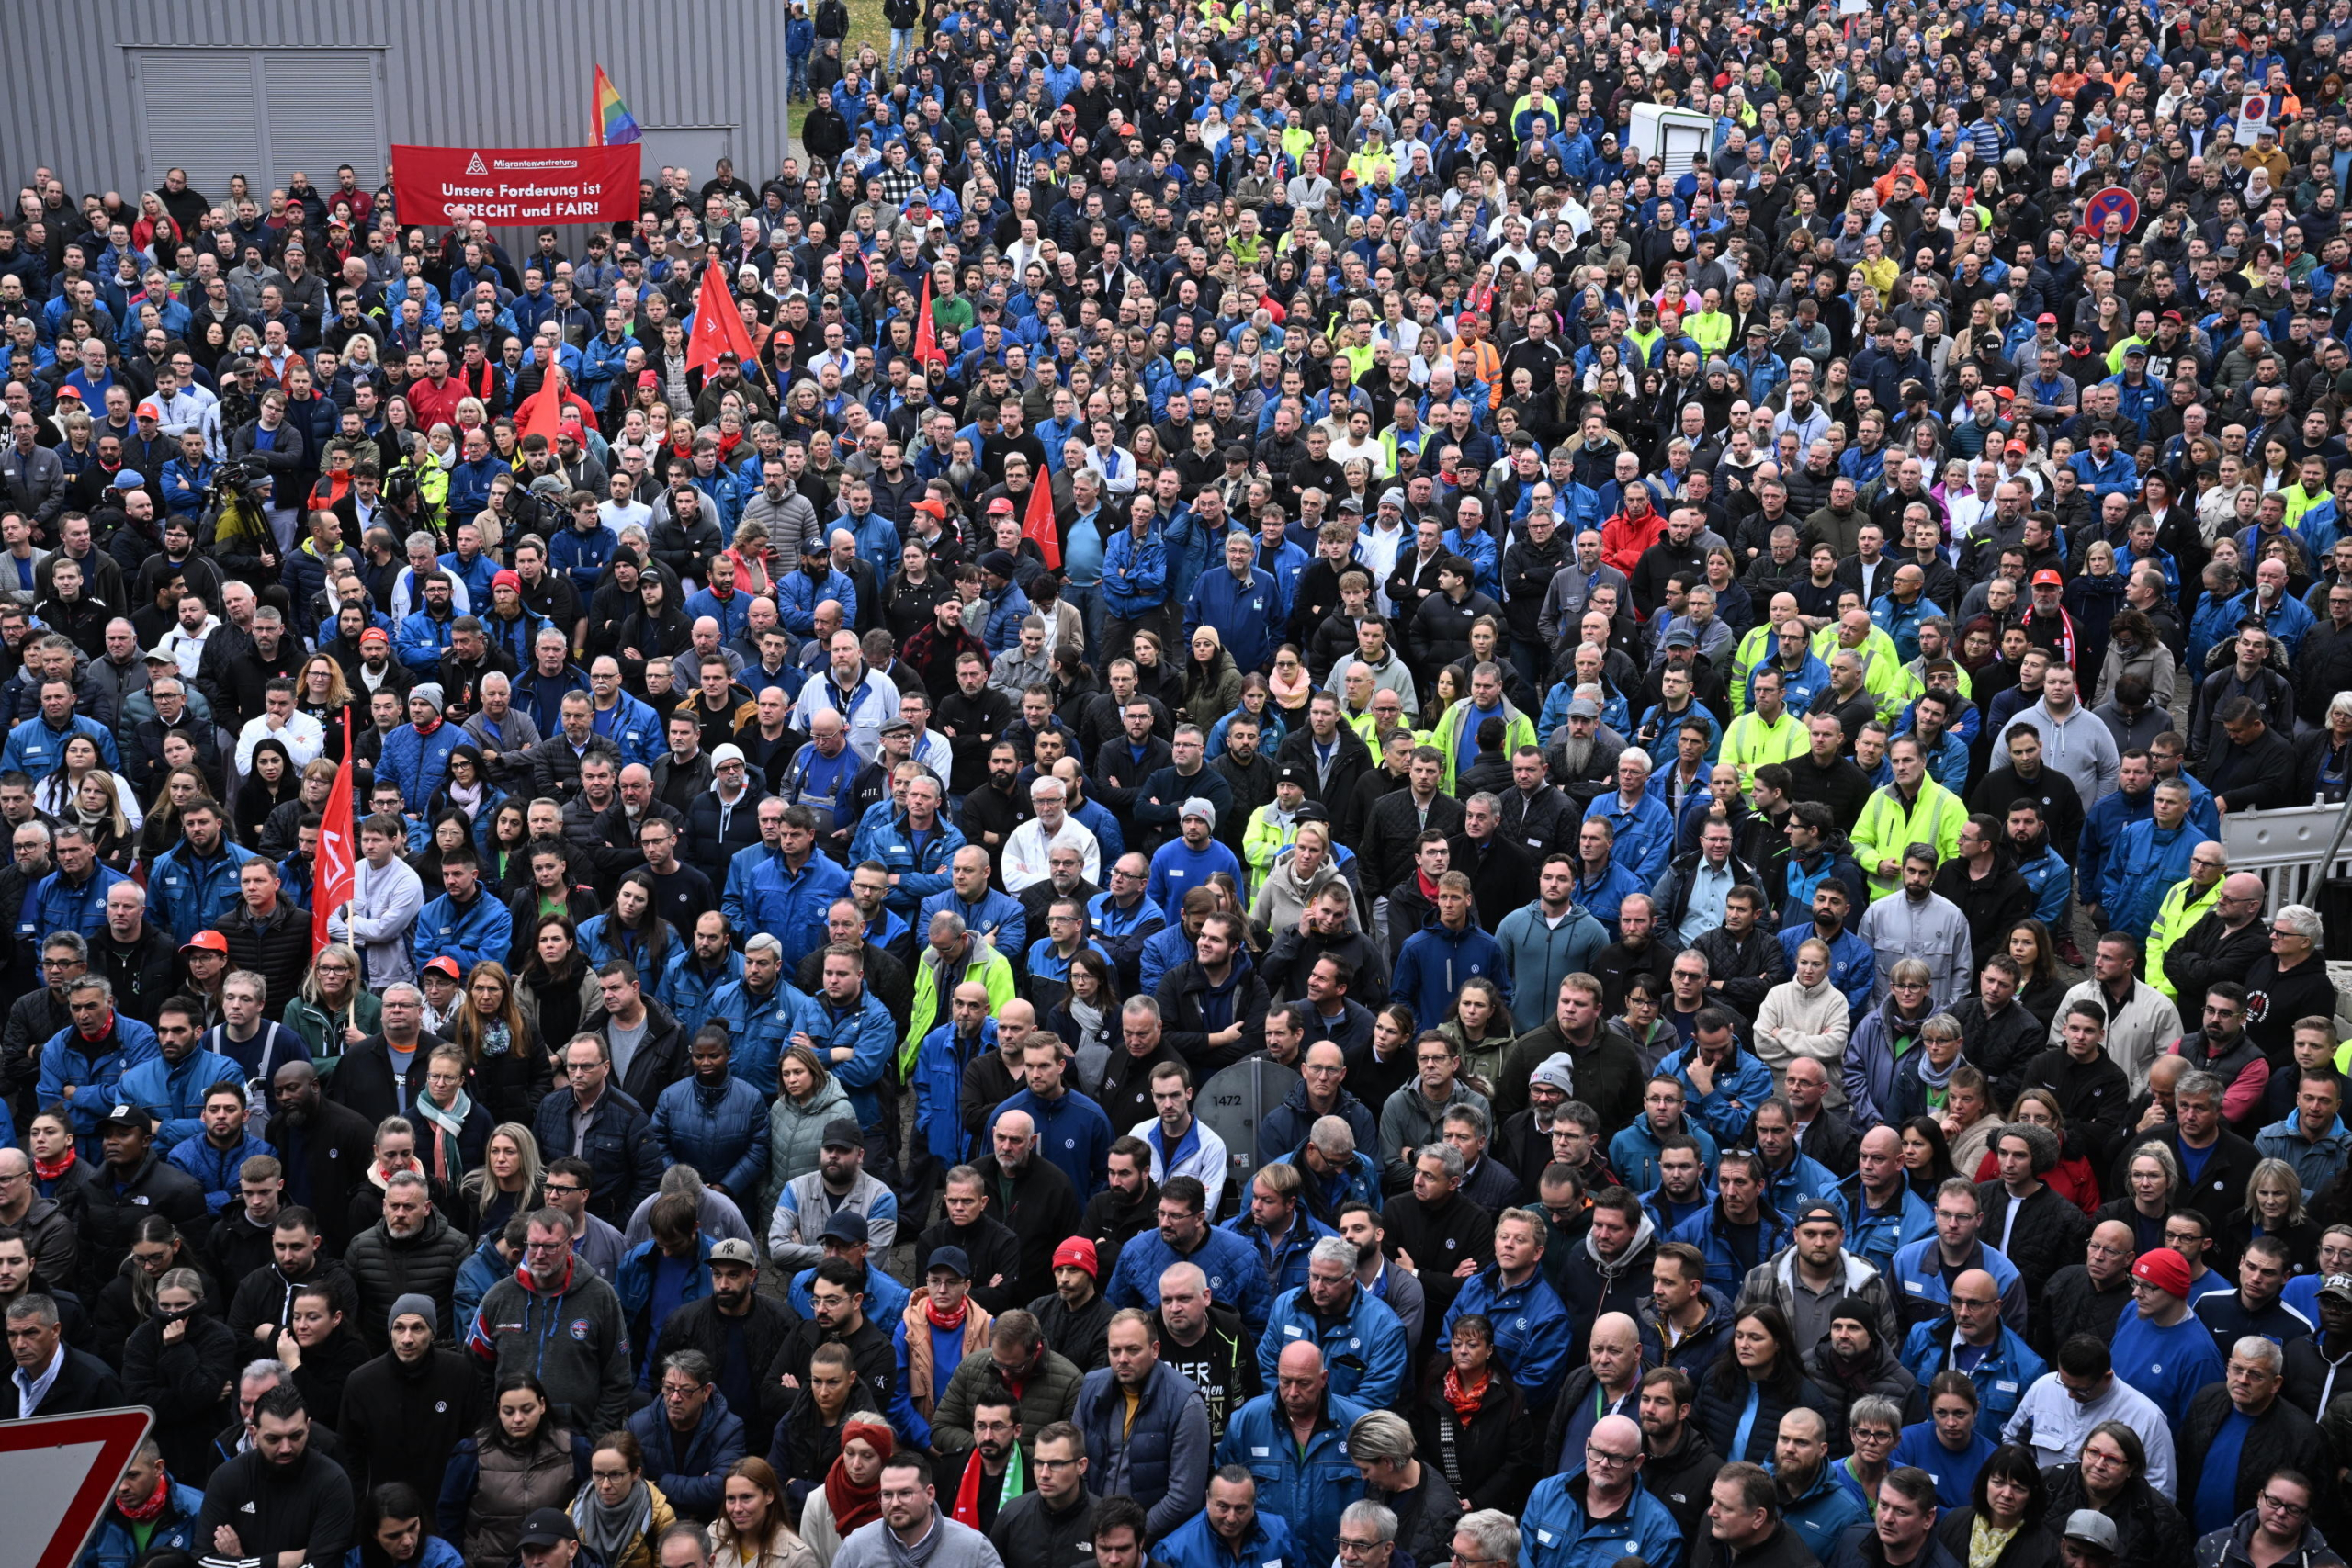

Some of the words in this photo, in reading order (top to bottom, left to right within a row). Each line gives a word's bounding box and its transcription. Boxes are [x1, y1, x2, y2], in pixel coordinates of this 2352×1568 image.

[493, 159, 578, 170] Migrantenvertretung
[441, 182, 494, 197] Unsere
[499, 183, 578, 199] Forderung
[583, 182, 602, 196] ist
[443, 202, 517, 218] GRECHT
[521, 202, 550, 217] und
[556, 201, 599, 217] FAIR!
[1213, 1095, 1242, 1107] 1472
[2324, 1273, 2352, 1289] FBI
[1201, 1385, 1225, 1404] pfen
